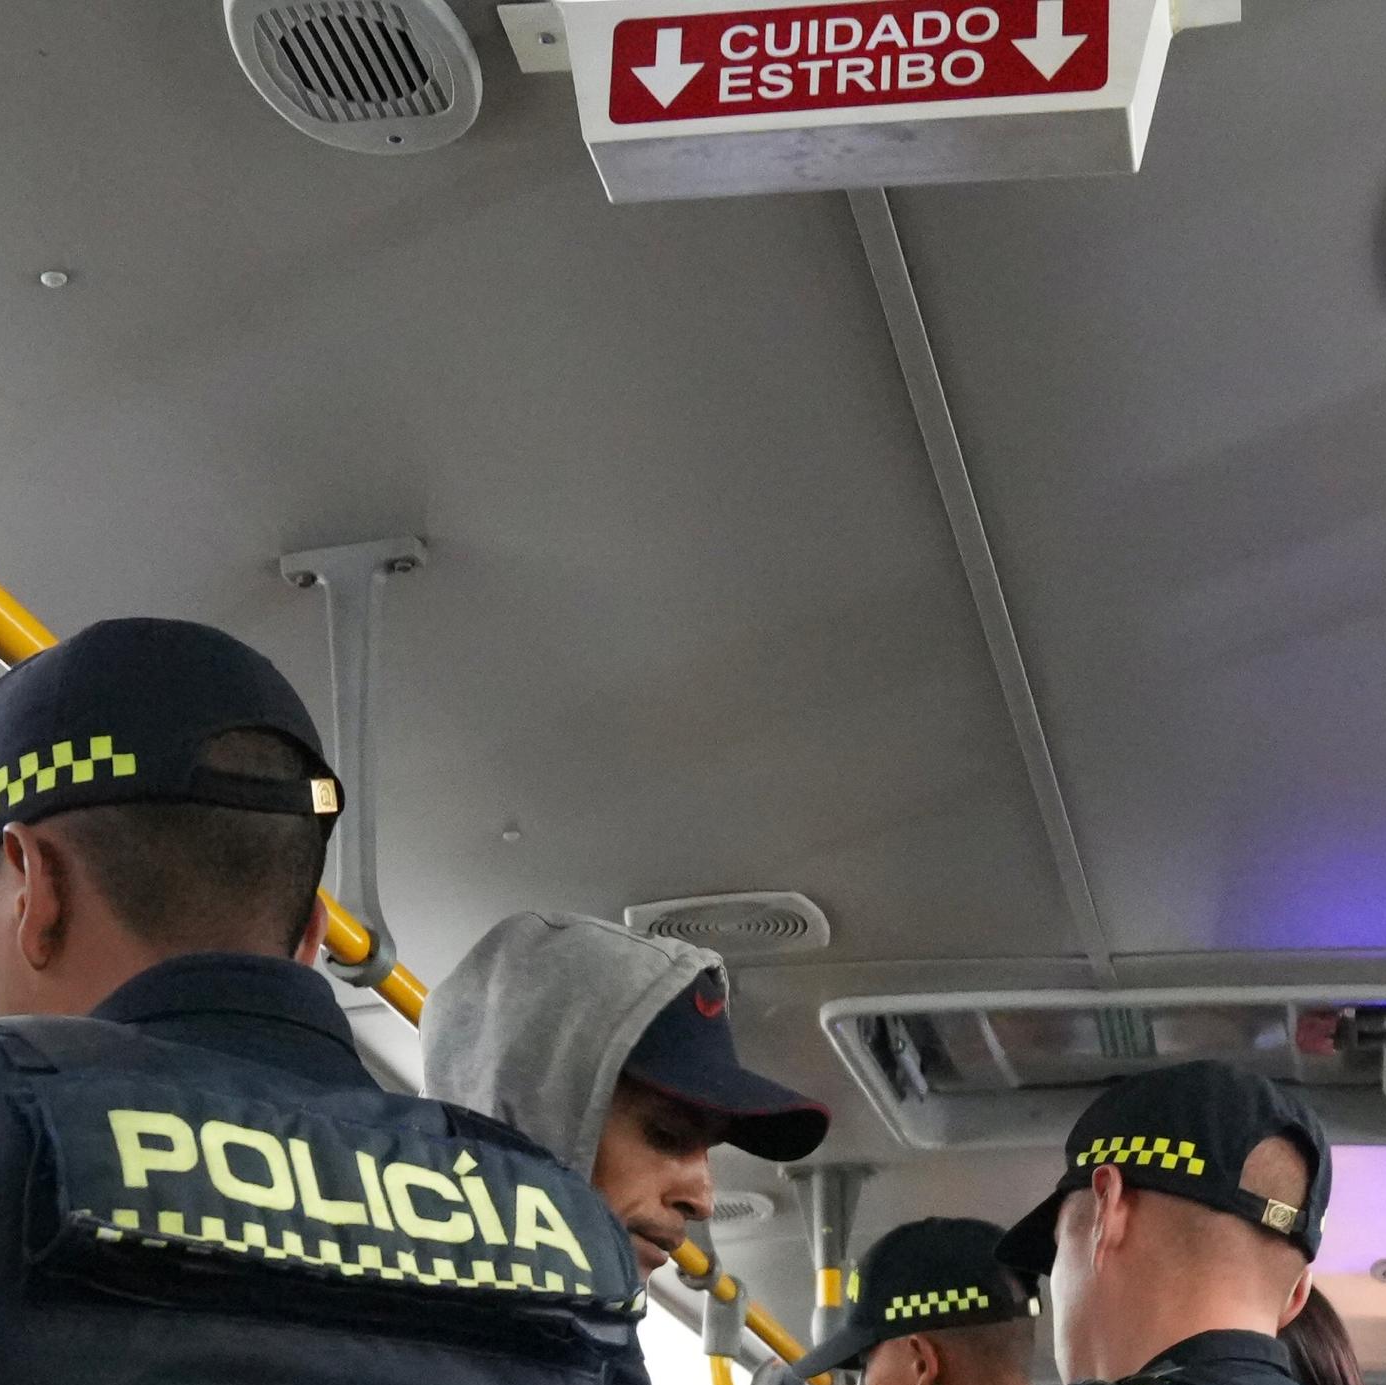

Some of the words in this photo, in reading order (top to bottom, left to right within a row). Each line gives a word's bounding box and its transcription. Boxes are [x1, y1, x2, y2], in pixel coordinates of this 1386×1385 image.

[719, 6, 1000, 61] CUIDADO
[718, 49, 985, 103] ESTRIBO
[107, 1109, 592, 1273] POLICÍA
